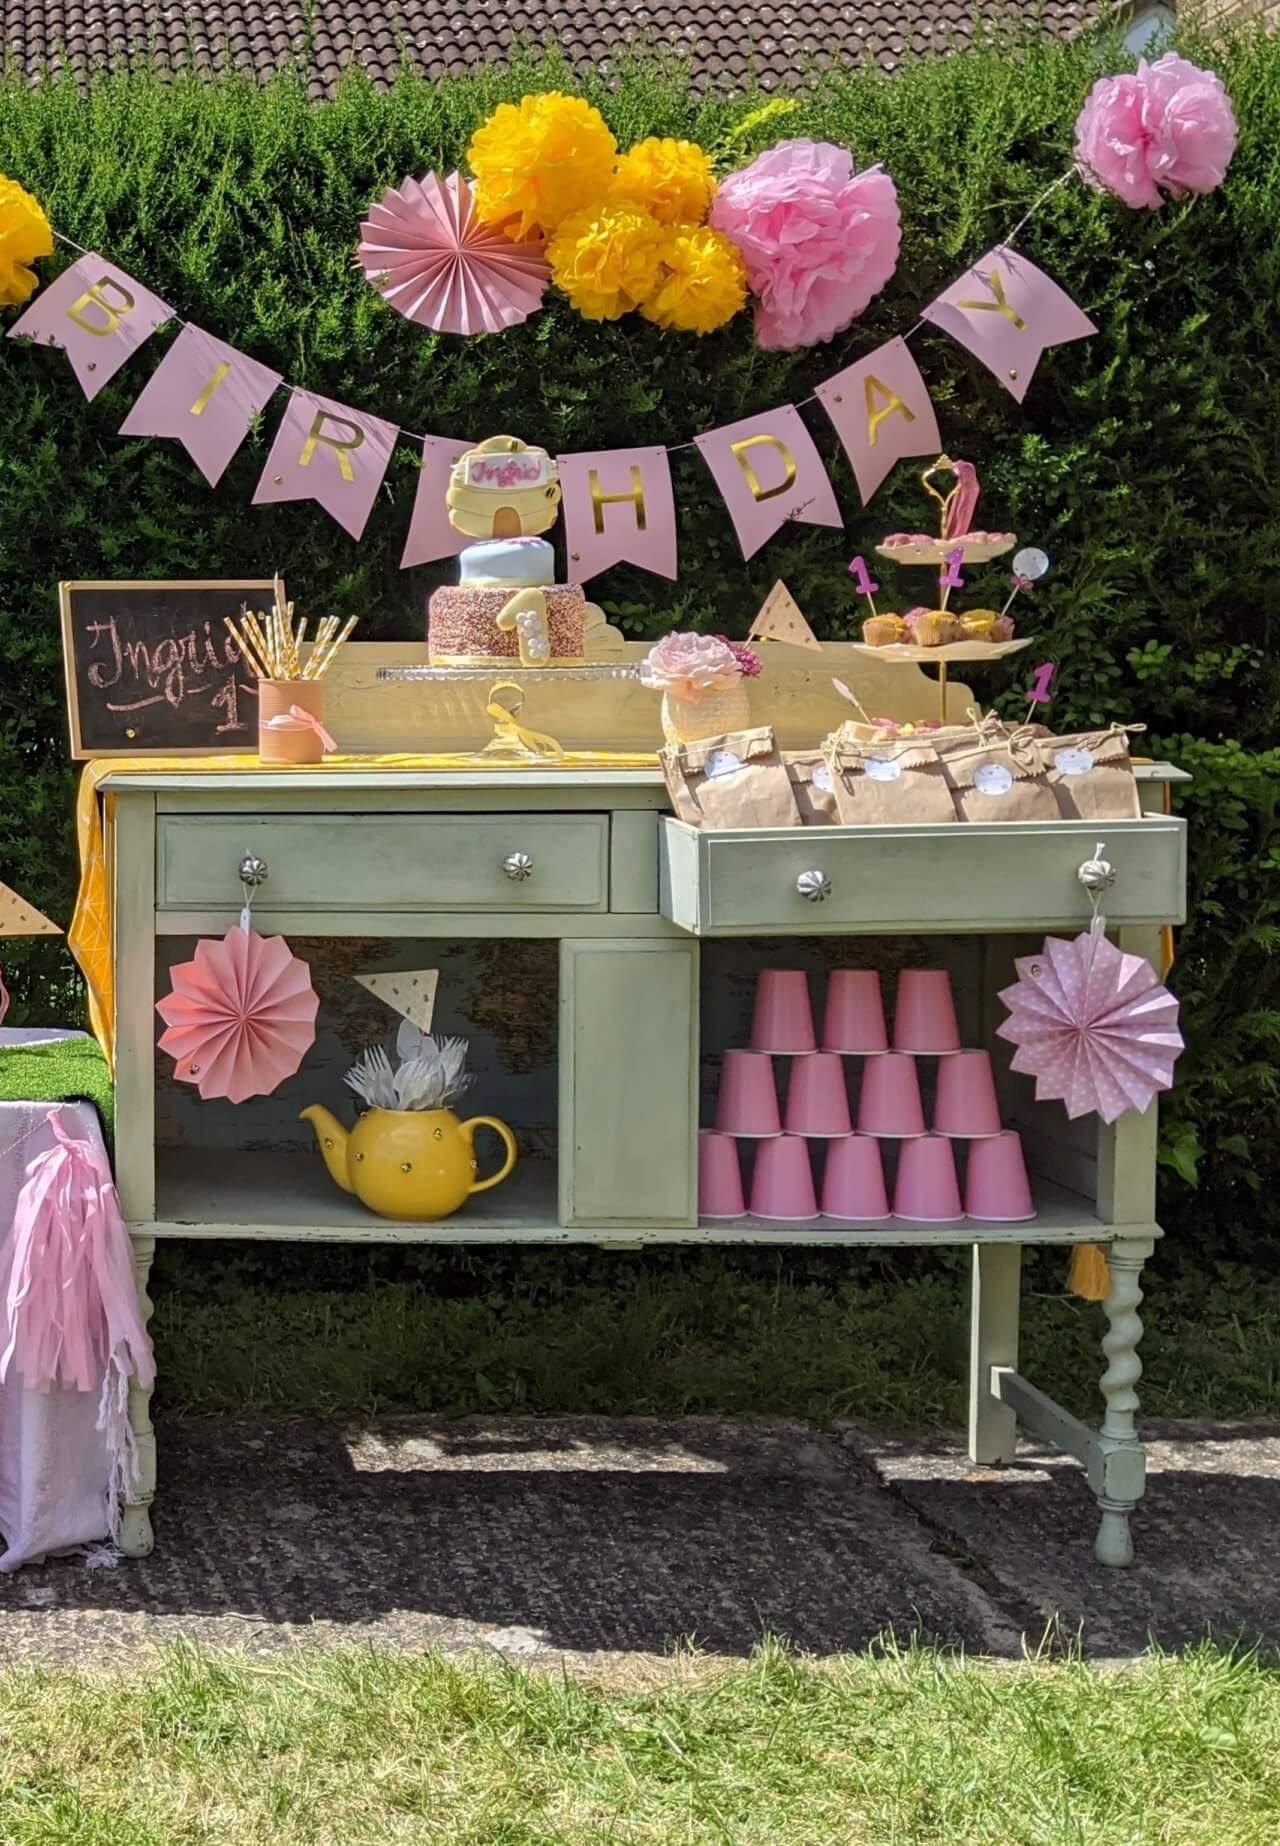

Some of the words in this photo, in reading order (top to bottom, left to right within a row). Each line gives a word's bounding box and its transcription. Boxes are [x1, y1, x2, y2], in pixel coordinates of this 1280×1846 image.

[67, 269, 1026, 535] BIRHDAY
[848, 556, 879, 594] 1
[939, 548, 964, 588] 1
[1027, 662, 1056, 702] 1
[212, 671, 248, 734] 1
